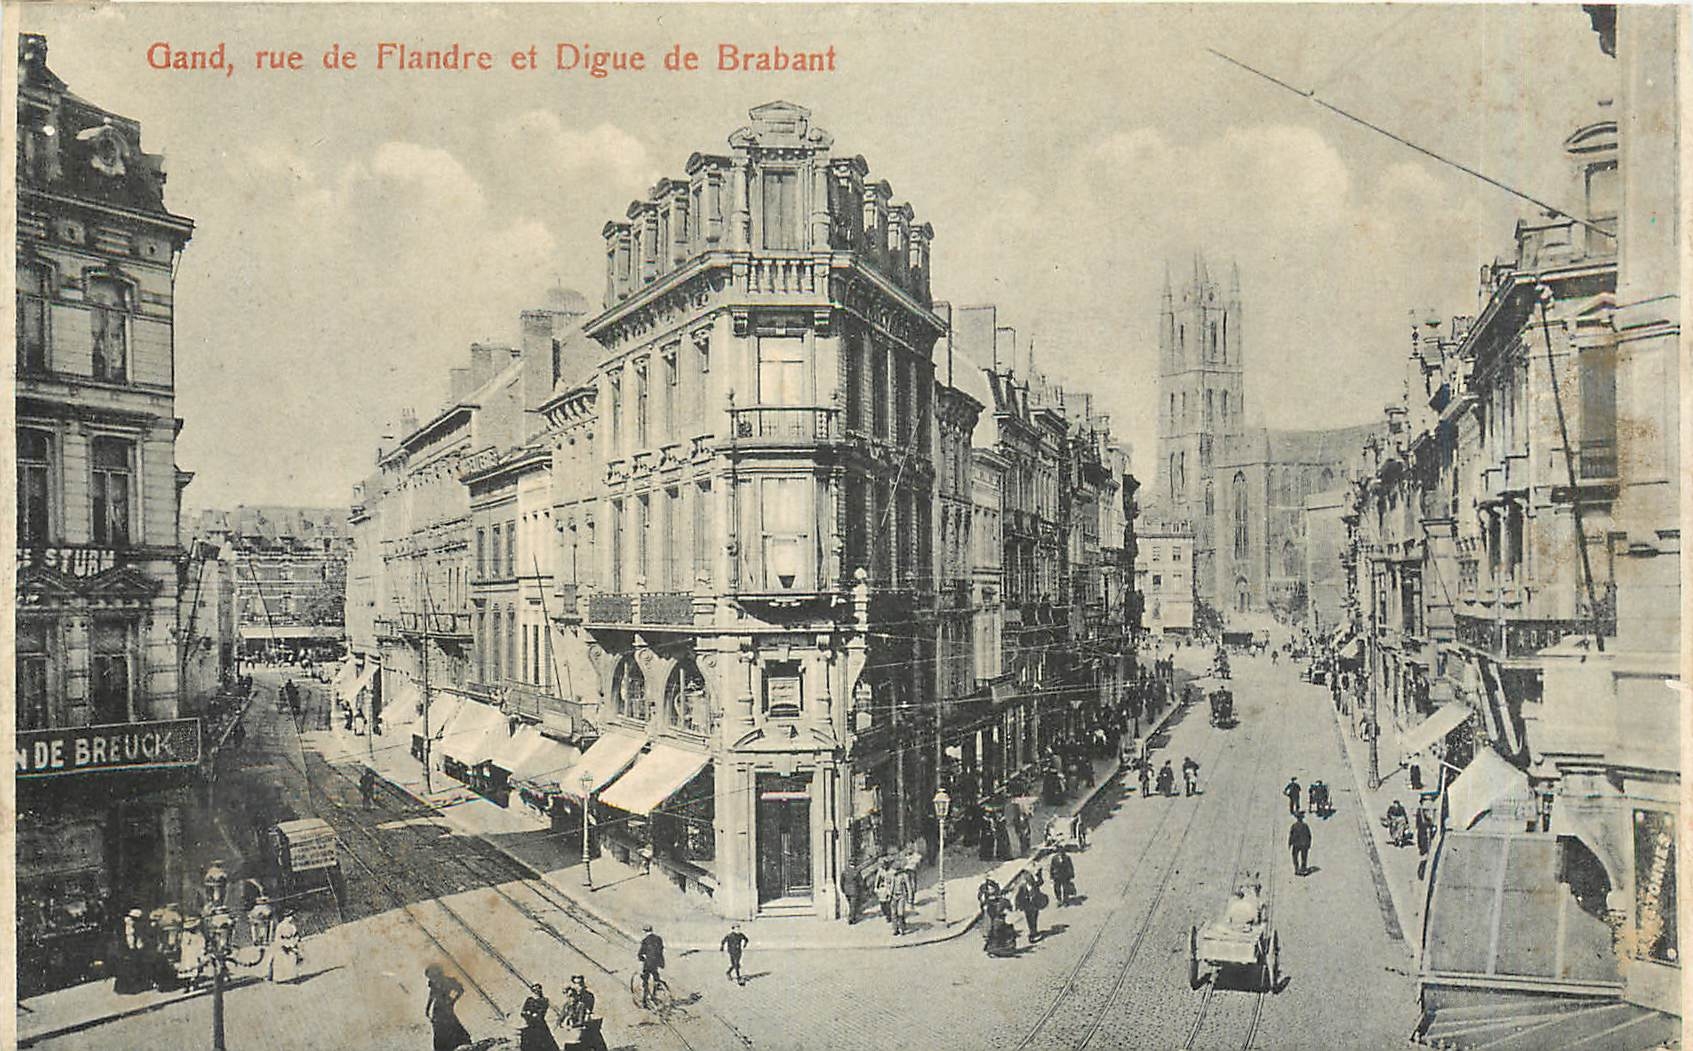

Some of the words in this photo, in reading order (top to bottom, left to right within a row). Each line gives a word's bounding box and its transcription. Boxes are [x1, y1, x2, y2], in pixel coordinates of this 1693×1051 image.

[45, 548, 115, 577] STURM
[34, 739, 65, 770] DE
[75, 731, 176, 765] BREUCK
